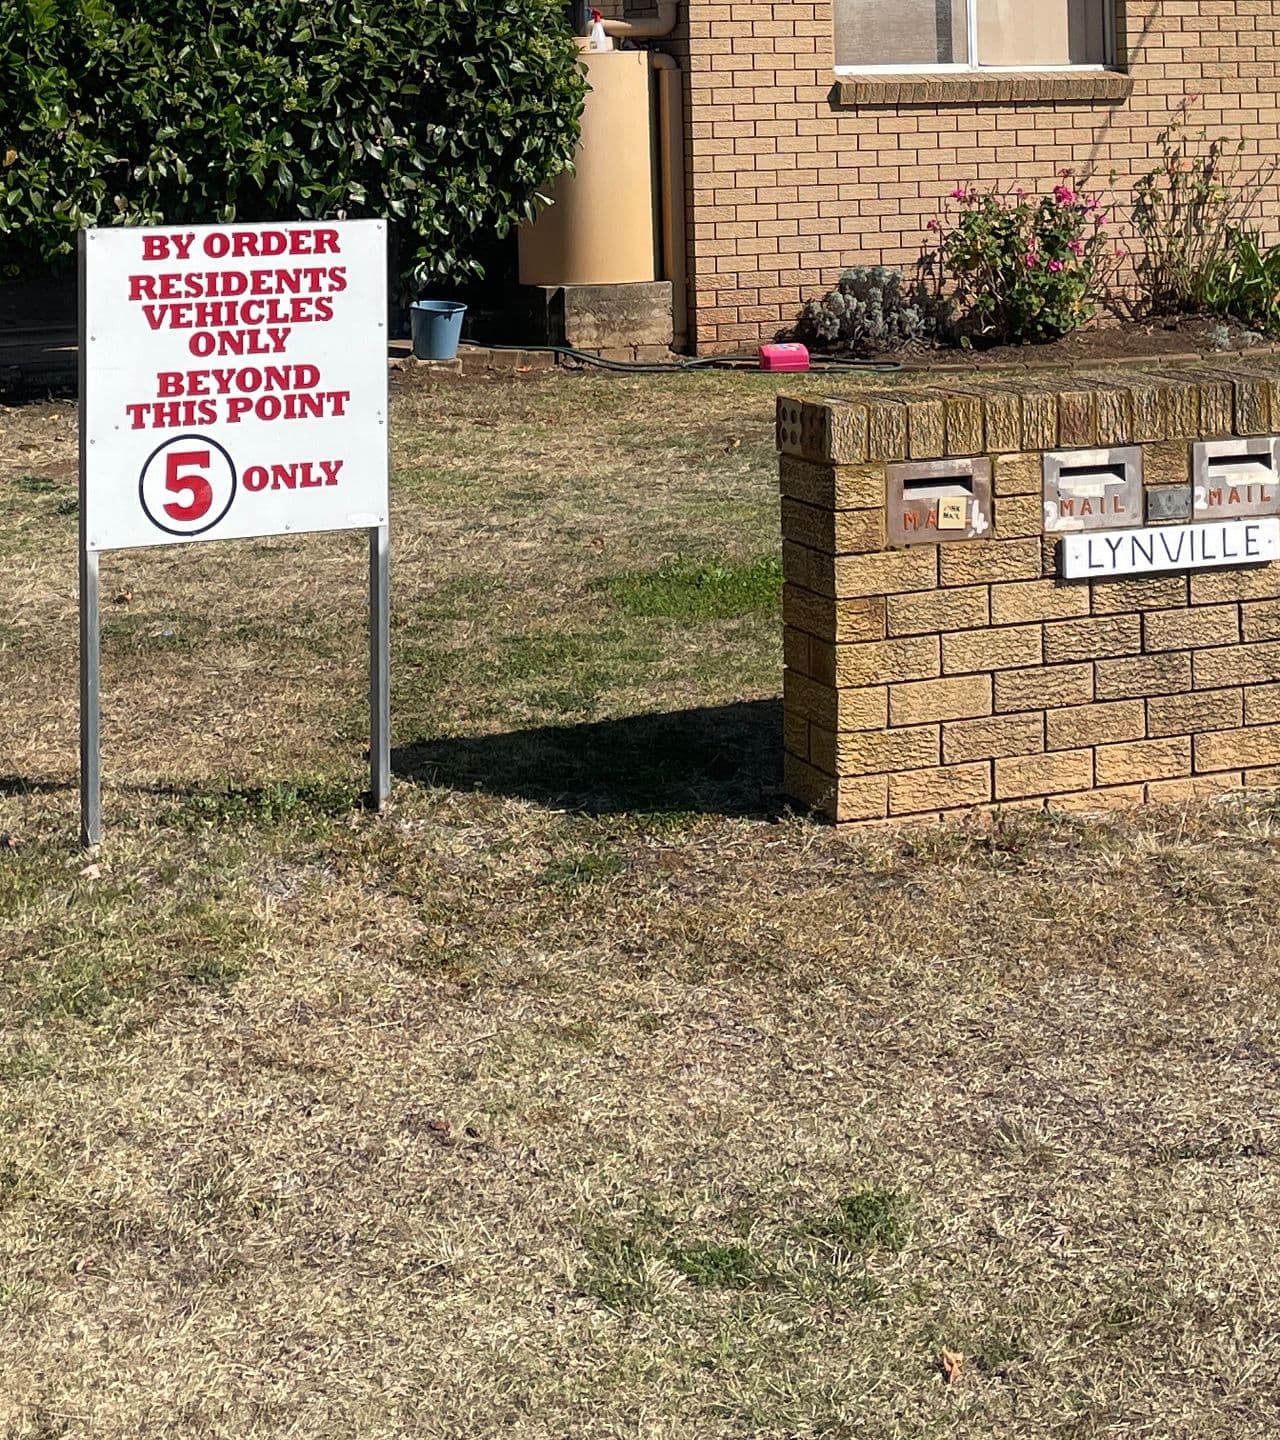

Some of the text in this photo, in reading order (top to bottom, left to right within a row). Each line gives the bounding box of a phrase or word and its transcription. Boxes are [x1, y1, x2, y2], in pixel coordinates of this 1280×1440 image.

[142, 229, 341, 260] BY ORDER
[128, 266, 347, 301] RESIDENTS
[141, 296, 333, 330] VEHICLES
[188, 327, 291, 357] ONLY
[157, 364, 320, 398] BEYOND
[126, 391, 350, 430] THIS POINT
[163, 450, 344, 522] 5 ONLY
[1194, 486, 1208, 510] 2
[1208, 484, 1271, 506] MAIL
[1060, 494, 1125, 517] MAIL
[1088, 525, 1260, 569] LYNVILLE
